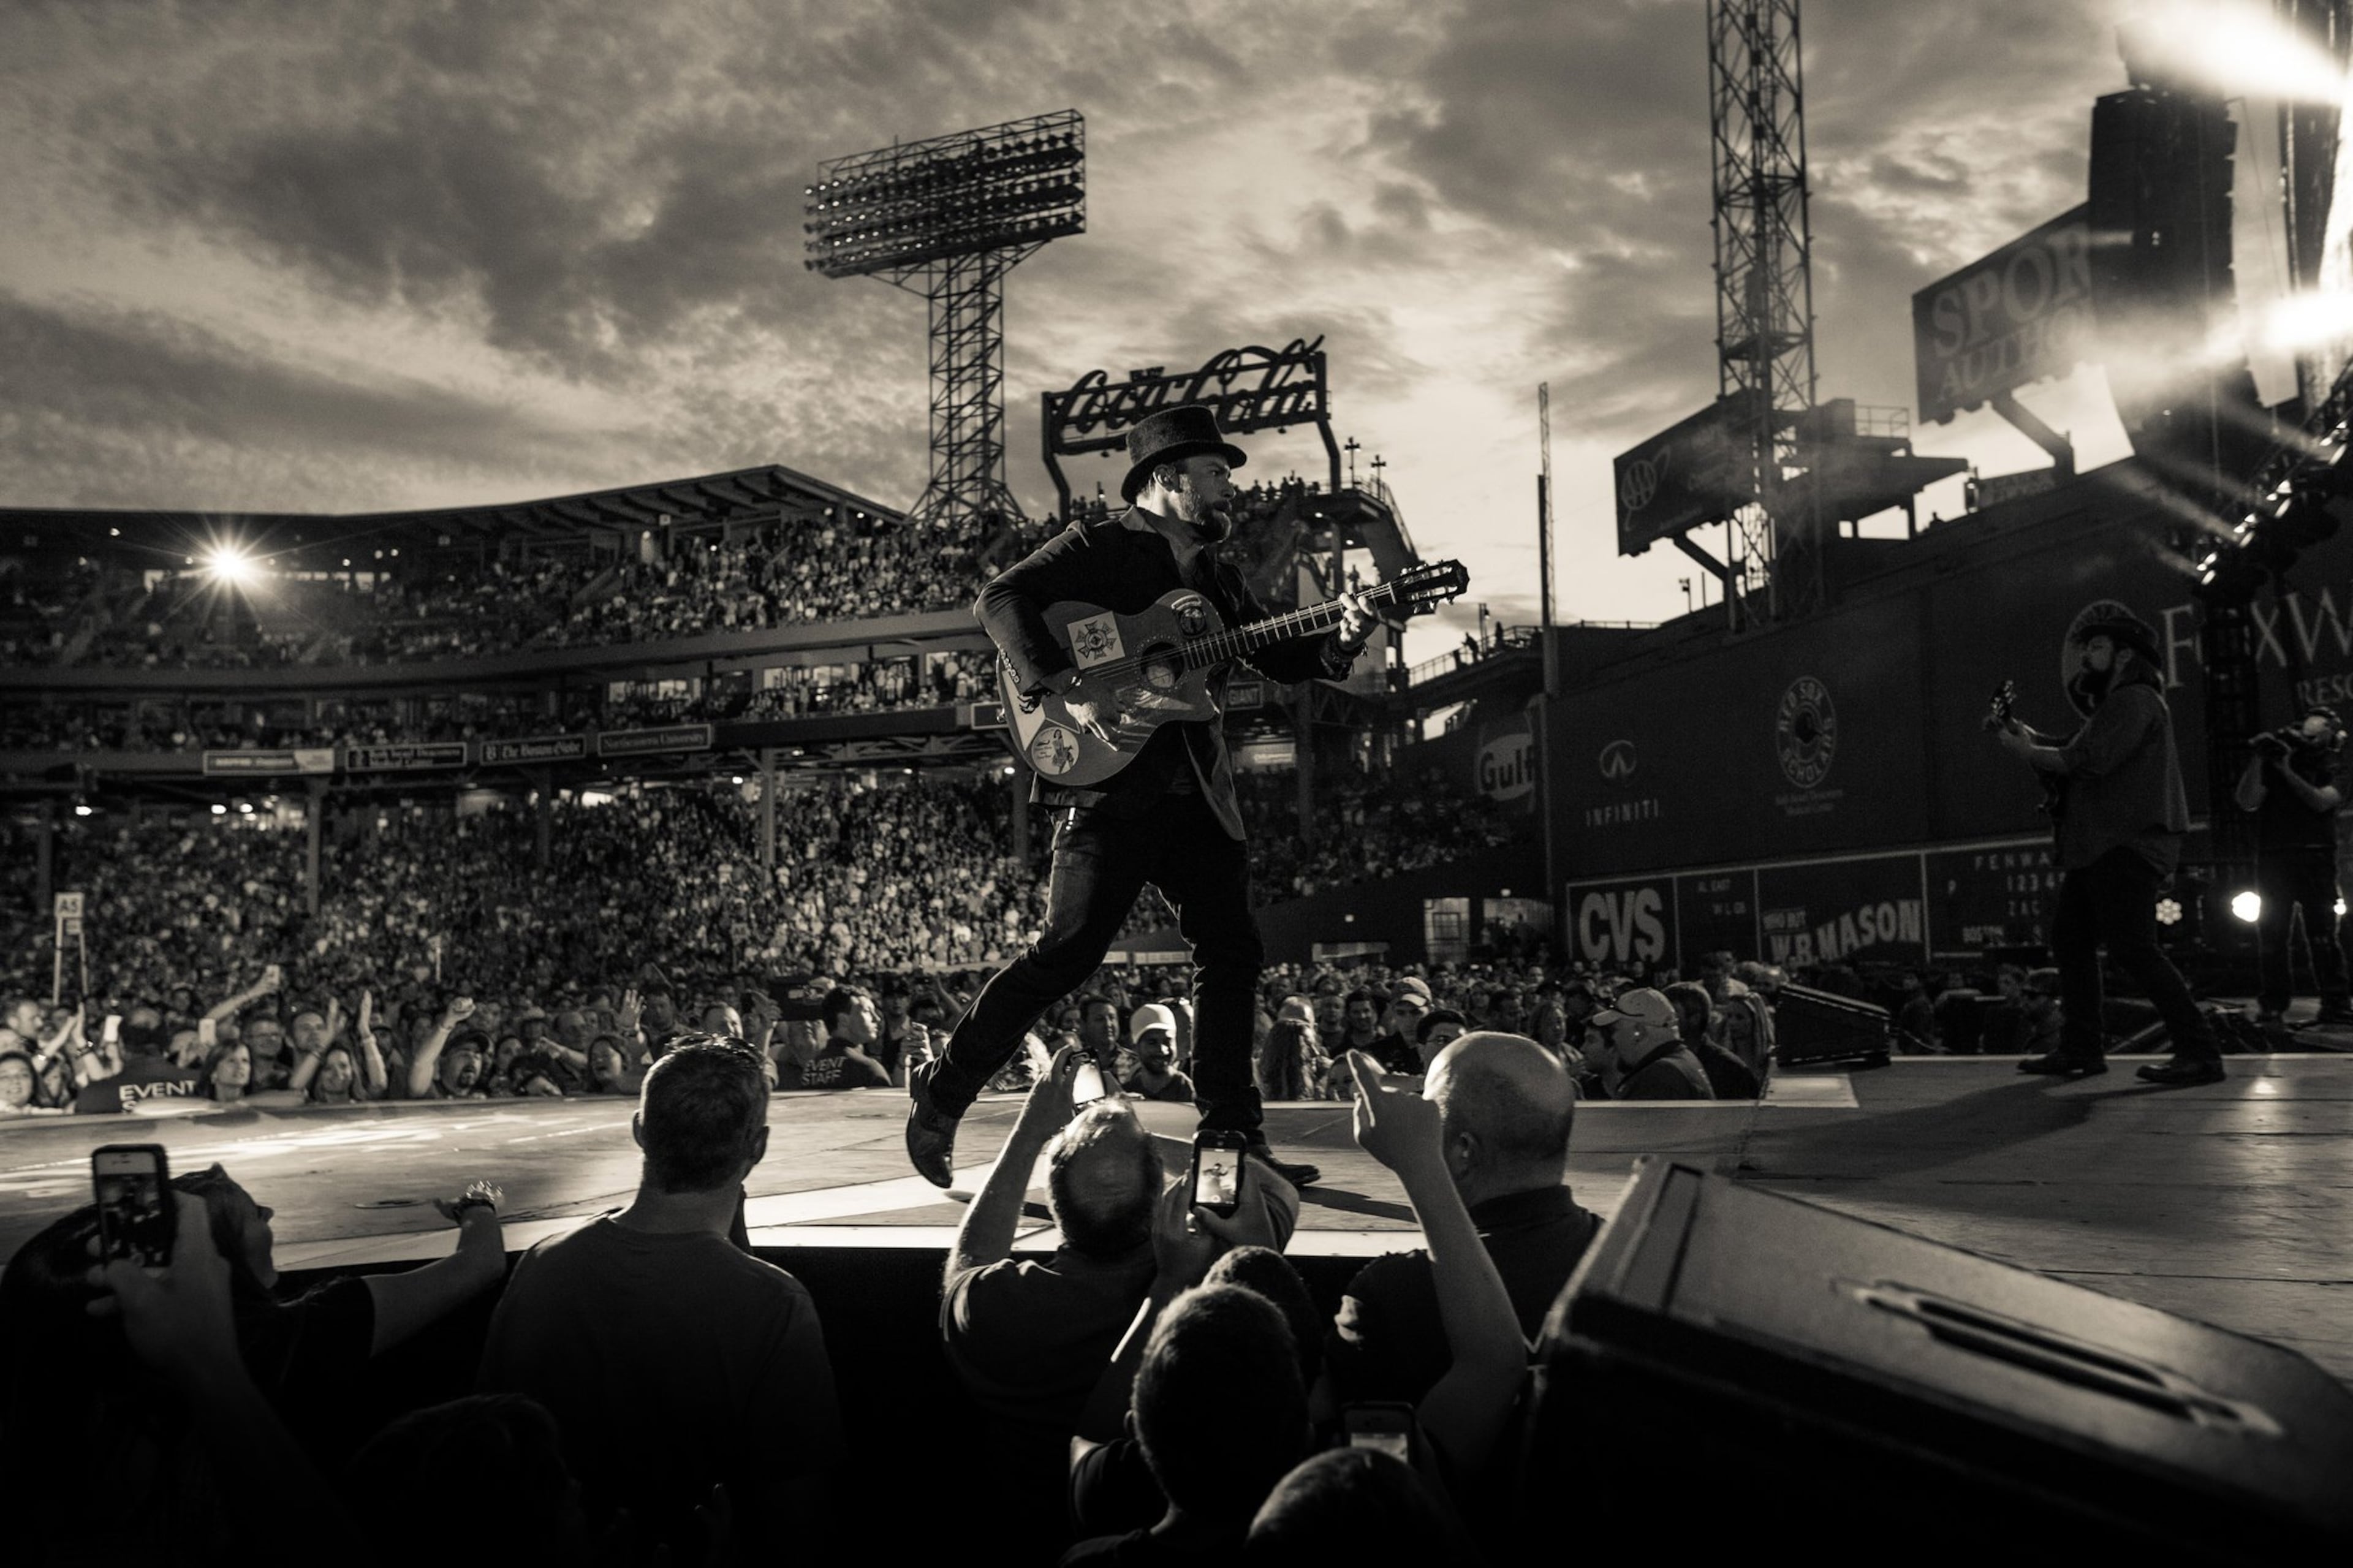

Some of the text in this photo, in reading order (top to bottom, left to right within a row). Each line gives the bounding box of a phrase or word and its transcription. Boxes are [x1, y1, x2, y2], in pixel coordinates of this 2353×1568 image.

[1931, 223, 2091, 358] SPOR
[1938, 305, 2078, 403] AUTHO
[2157, 587, 2353, 689] FXW
[1799, 683, 1823, 706] SOX
[1480, 746, 1533, 792] Gulf
[1585, 798, 1659, 827] INFINITI
[1974, 851, 2052, 871] FENWA
[1579, 887, 1664, 963] CVS
[1816, 900, 1922, 962] MASON
[801, 1069, 842, 1086] STAFF
[804, 1056, 847, 1073] EVENT
[119, 1080, 196, 1102] EVENT
